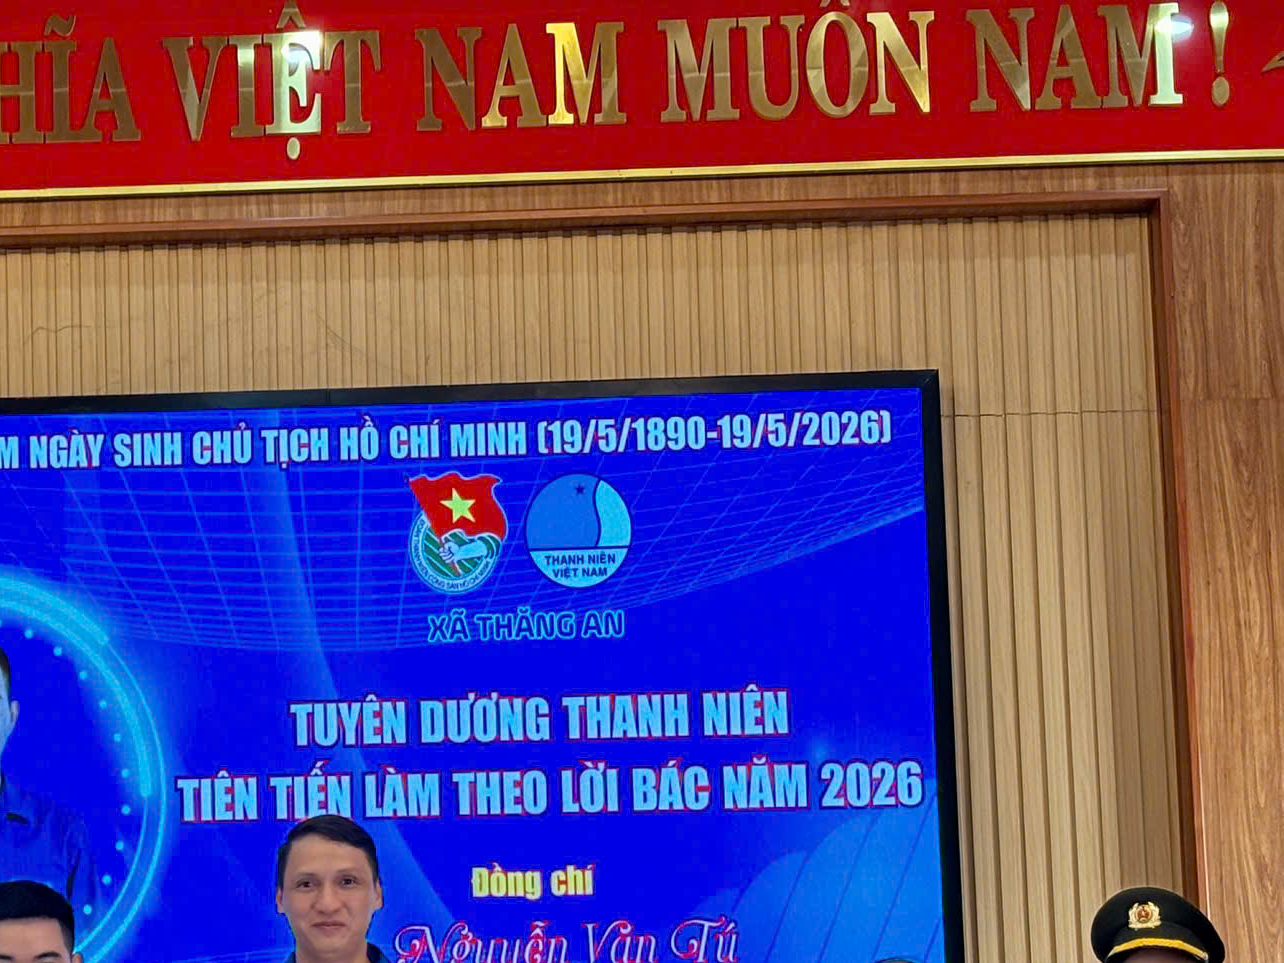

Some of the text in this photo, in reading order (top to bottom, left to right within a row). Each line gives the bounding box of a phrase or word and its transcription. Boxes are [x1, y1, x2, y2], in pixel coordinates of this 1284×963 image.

[164, 0, 381, 160] VIỆT
[415, 22, 627, 132] NAM
[658, 0, 934, 122] MUÔN
[30, 428, 104, 469] NGÀY
[114, 432, 182, 467] SINH
[193, 422, 251, 465] CHỦ
[261, 428, 328, 470] TỊCH
[340, 413, 379, 461] HỒ
[390, 418, 440, 459] CHÍ
[451, 422, 527, 457] MINH
[544, 552, 616, 566] THANH NIÊN
[552, 566, 608, 580] VIỆT NAM
[428, 605, 625, 643] XÃ THĂNG AN
[290, 683, 790, 746] TUYÊN DƯƠNG THANH NIÊN
[177, 756, 923, 821] TIÊN TIẾN LÀM THEO LỜI BÁC NĂM 2026
[472, 862, 595, 900] Đồng chí
